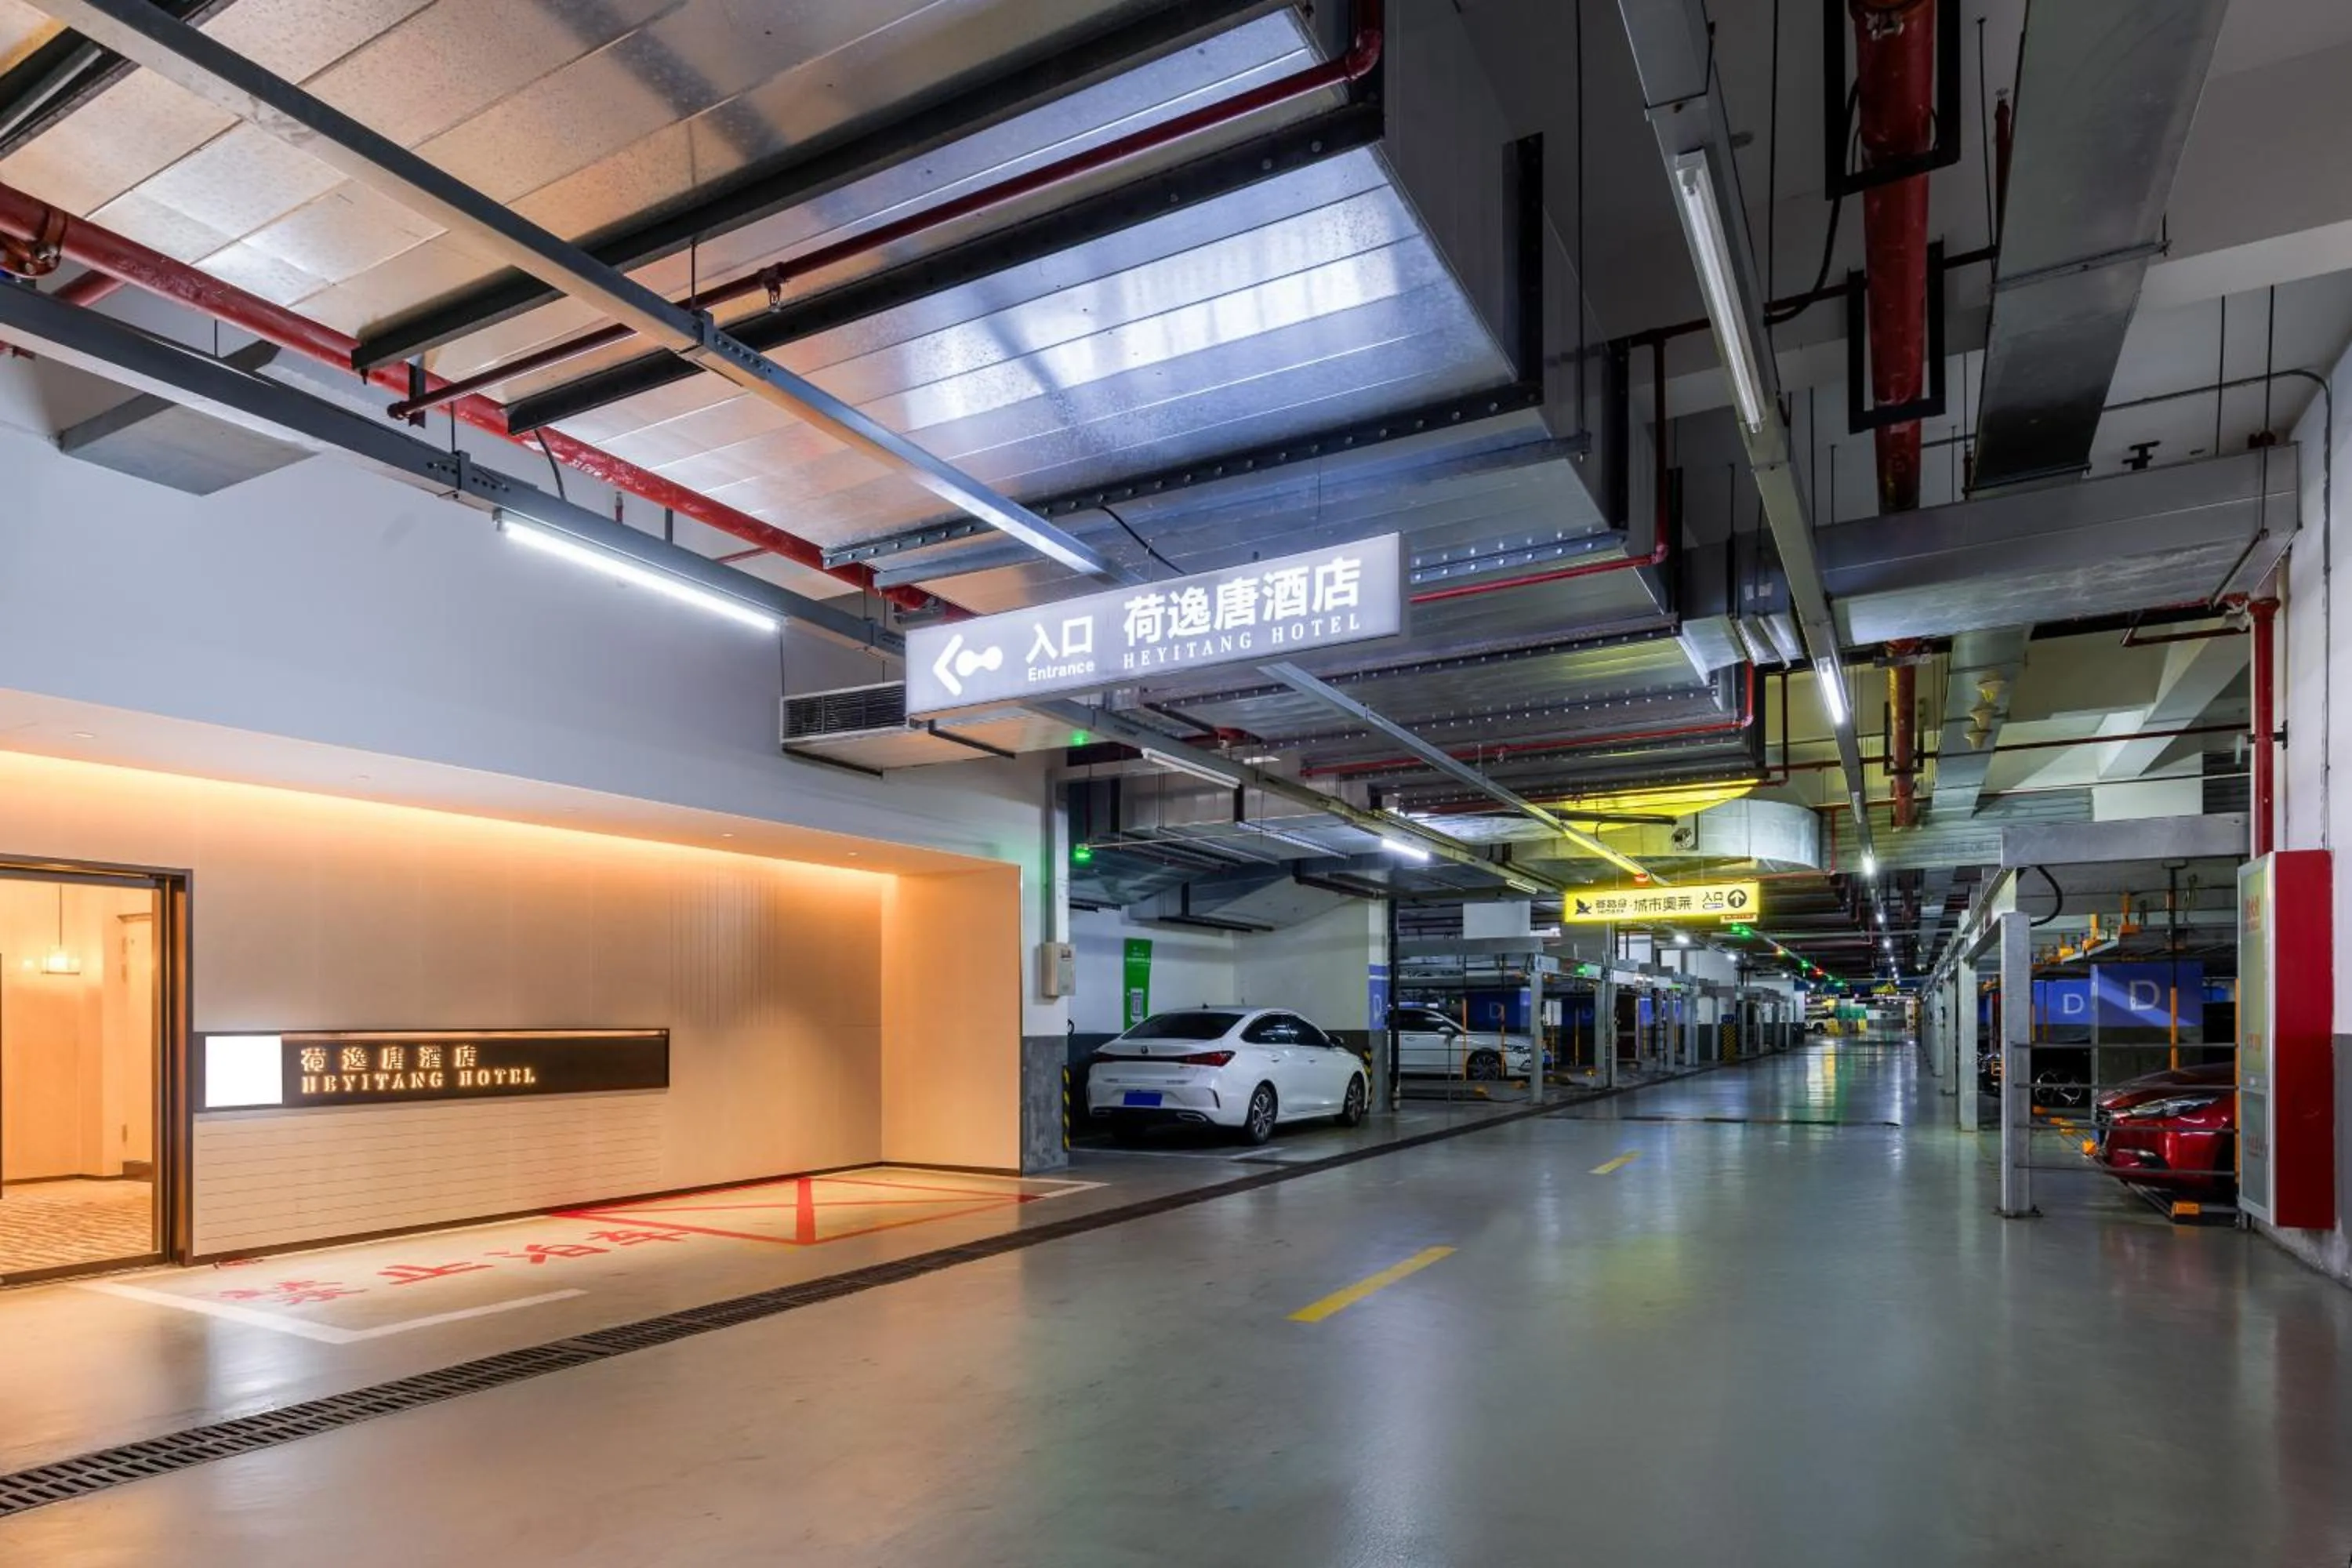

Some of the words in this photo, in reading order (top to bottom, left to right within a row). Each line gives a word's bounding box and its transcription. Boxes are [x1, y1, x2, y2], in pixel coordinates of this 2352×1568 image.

[1123, 557, 1362, 648] 荷逸唐酒店
[1025, 615, 1094, 664] 入口
[1123, 632, 1252, 670] HEYITANG
[1272, 613, 1361, 644] HOTEL
[1028, 660, 1095, 682] Entrance
[1702, 891, 1723, 902] 入口
[2063, 993, 2085, 1014] D
[2130, 980, 2161, 1011] D
[302, 1071, 445, 1094] HEYITANG
[459, 1067, 537, 1087] HOTEL
